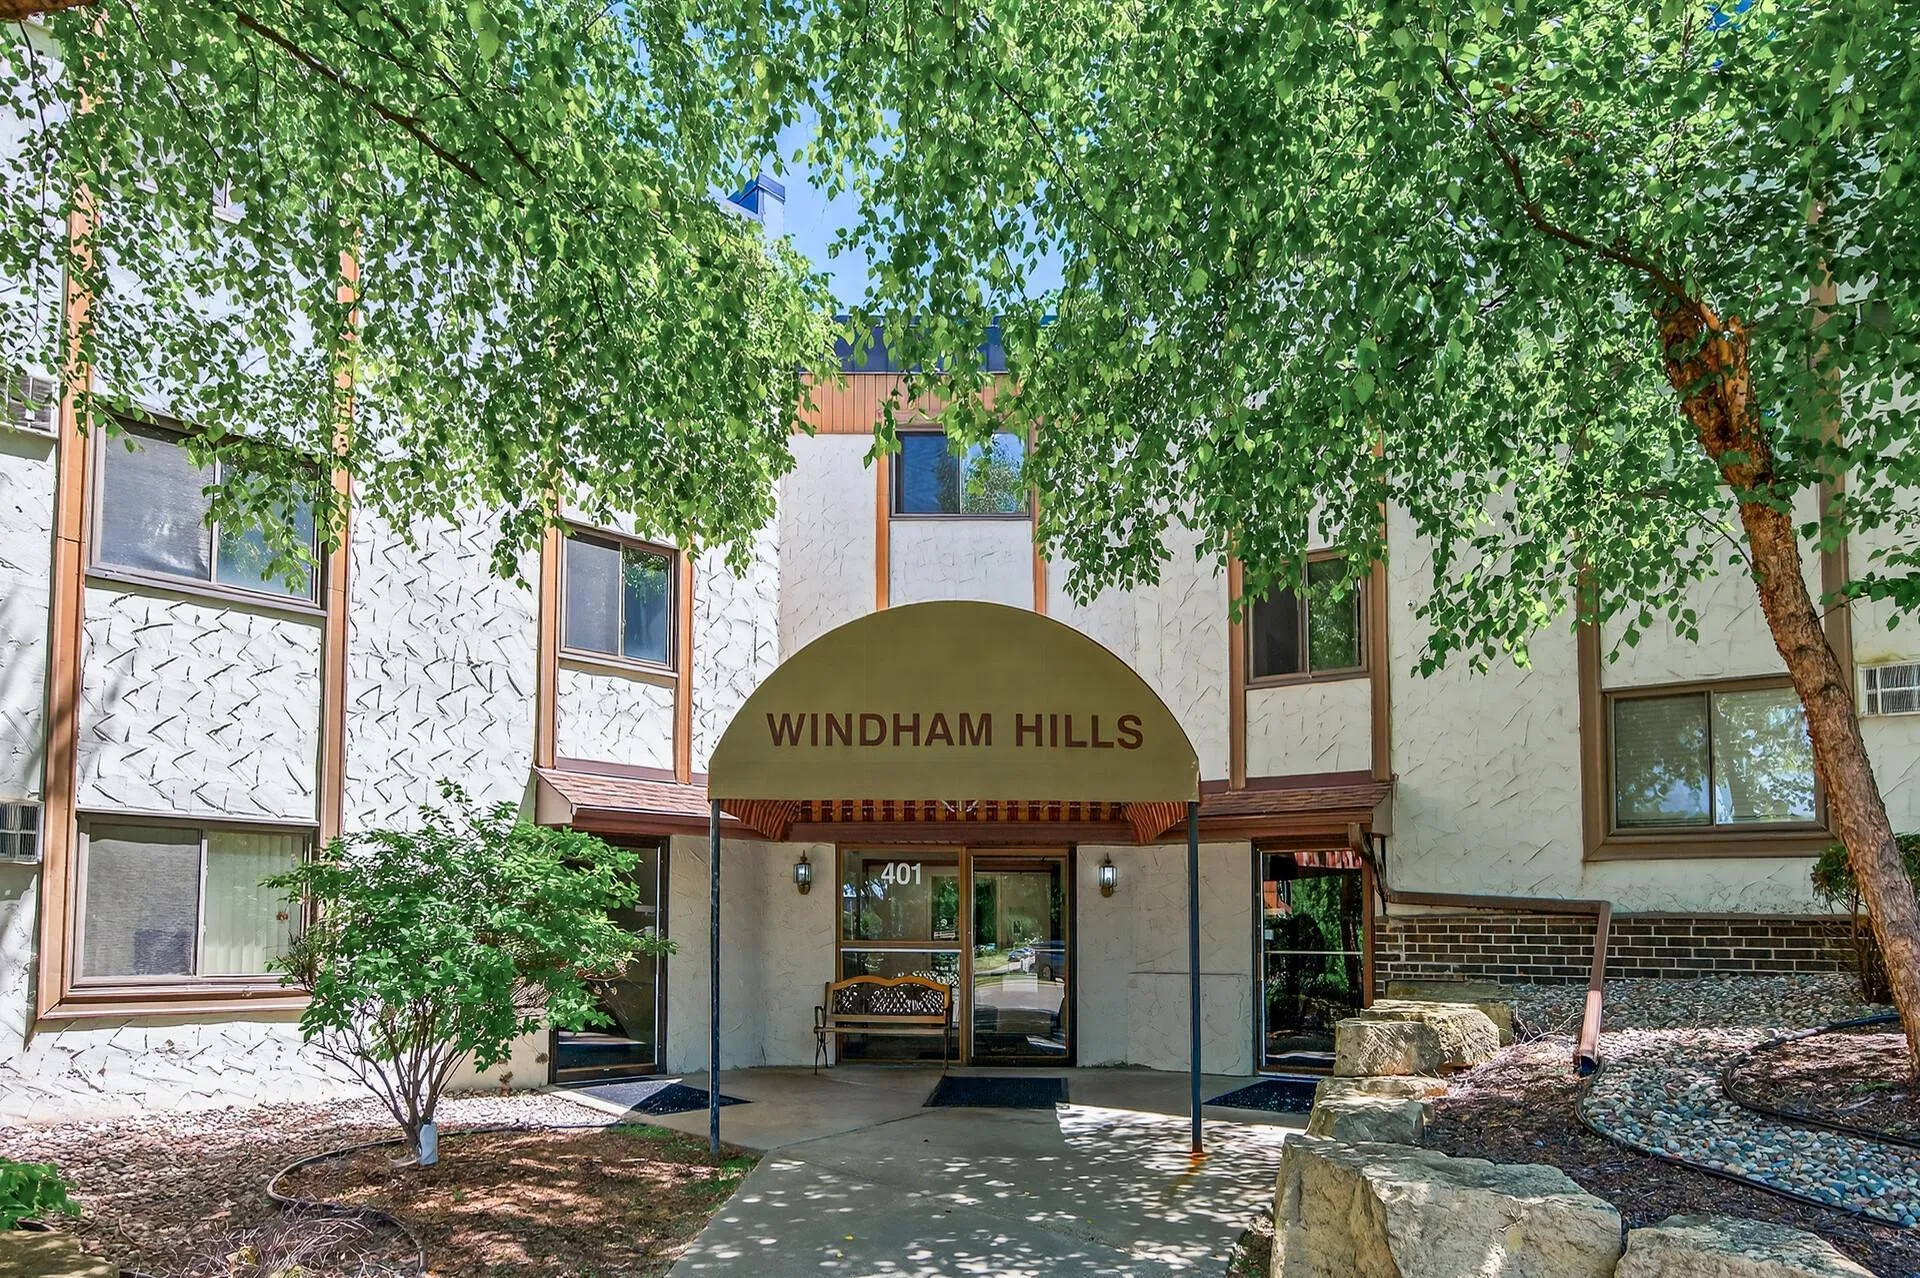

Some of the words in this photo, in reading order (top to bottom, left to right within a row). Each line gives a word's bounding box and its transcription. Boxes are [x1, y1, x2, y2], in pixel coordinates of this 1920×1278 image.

[766, 713, 992, 746] WINDHAM
[1016, 714, 1143, 749] HILLS
[881, 862, 921, 885] 401
